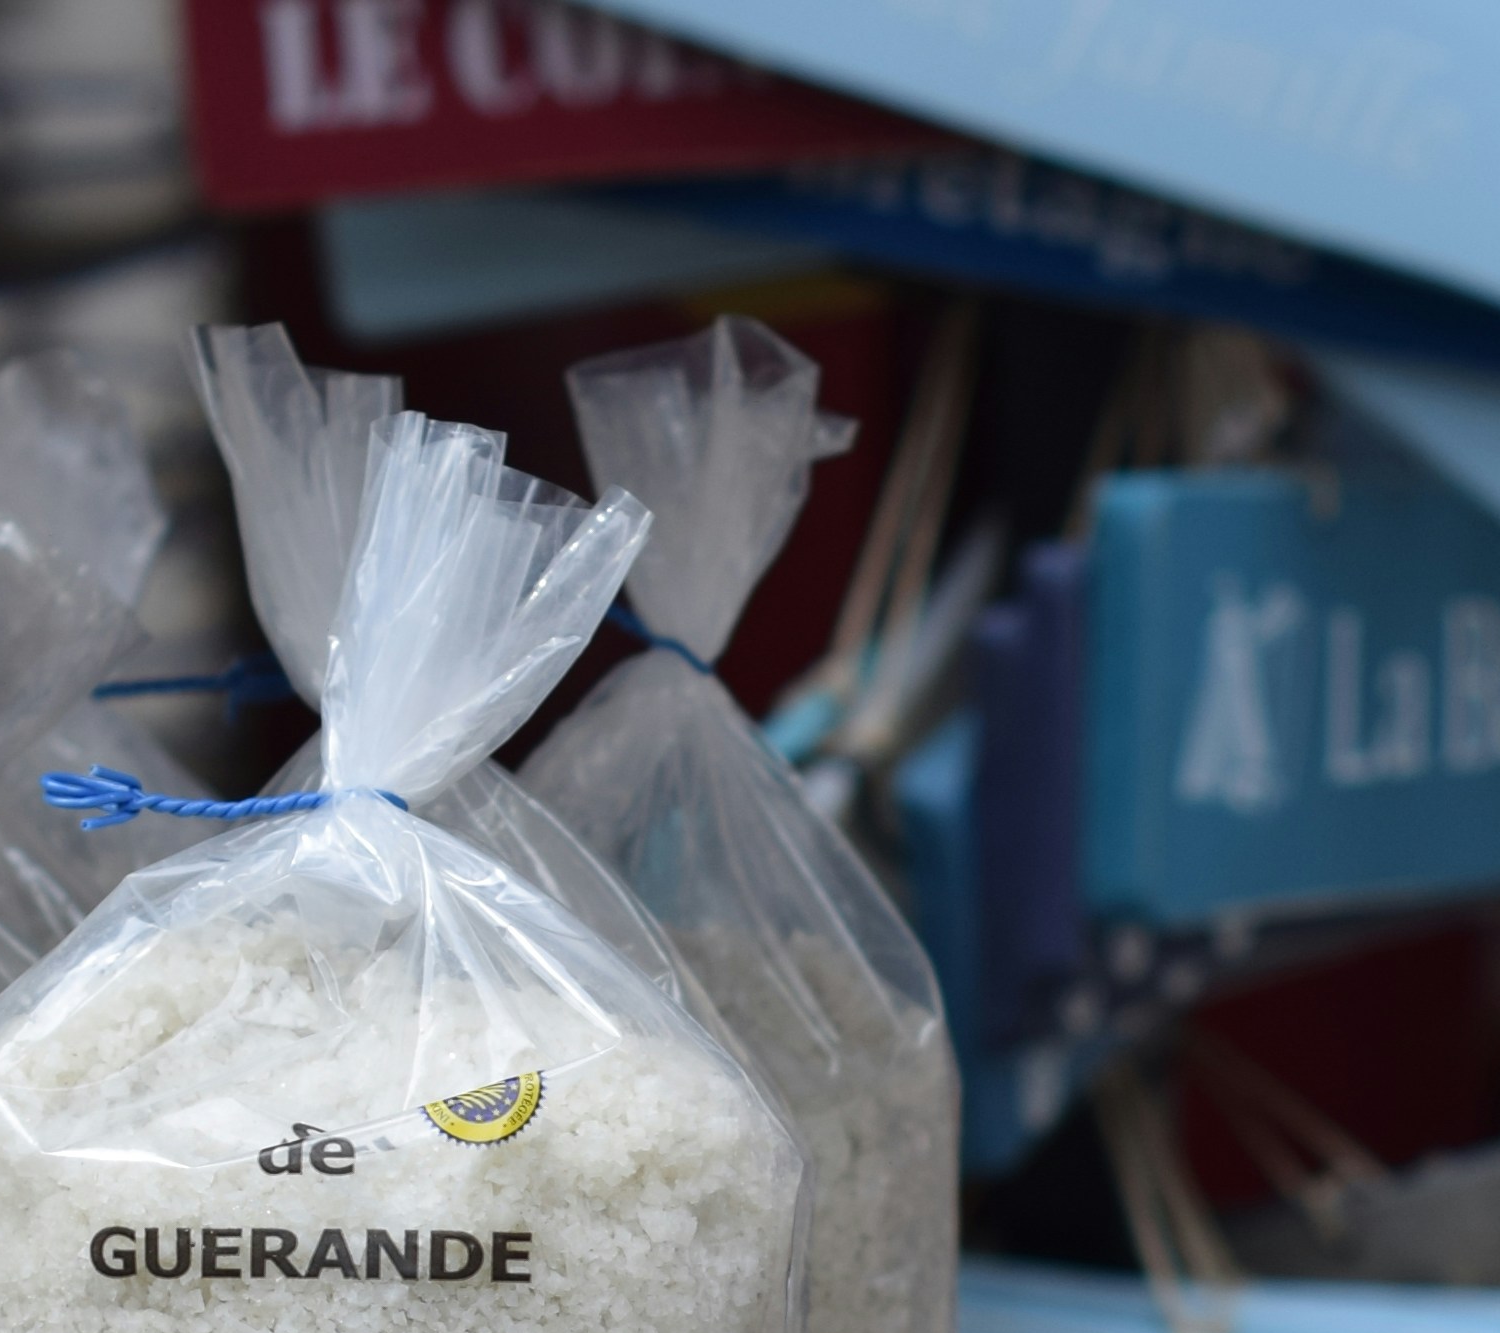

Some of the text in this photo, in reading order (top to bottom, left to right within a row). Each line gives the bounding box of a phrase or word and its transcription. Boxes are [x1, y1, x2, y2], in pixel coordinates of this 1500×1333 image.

[1324, 605, 1430, 782] La
[258, 1123, 355, 1175] de
[90, 1226, 532, 1283] GUERANDE
